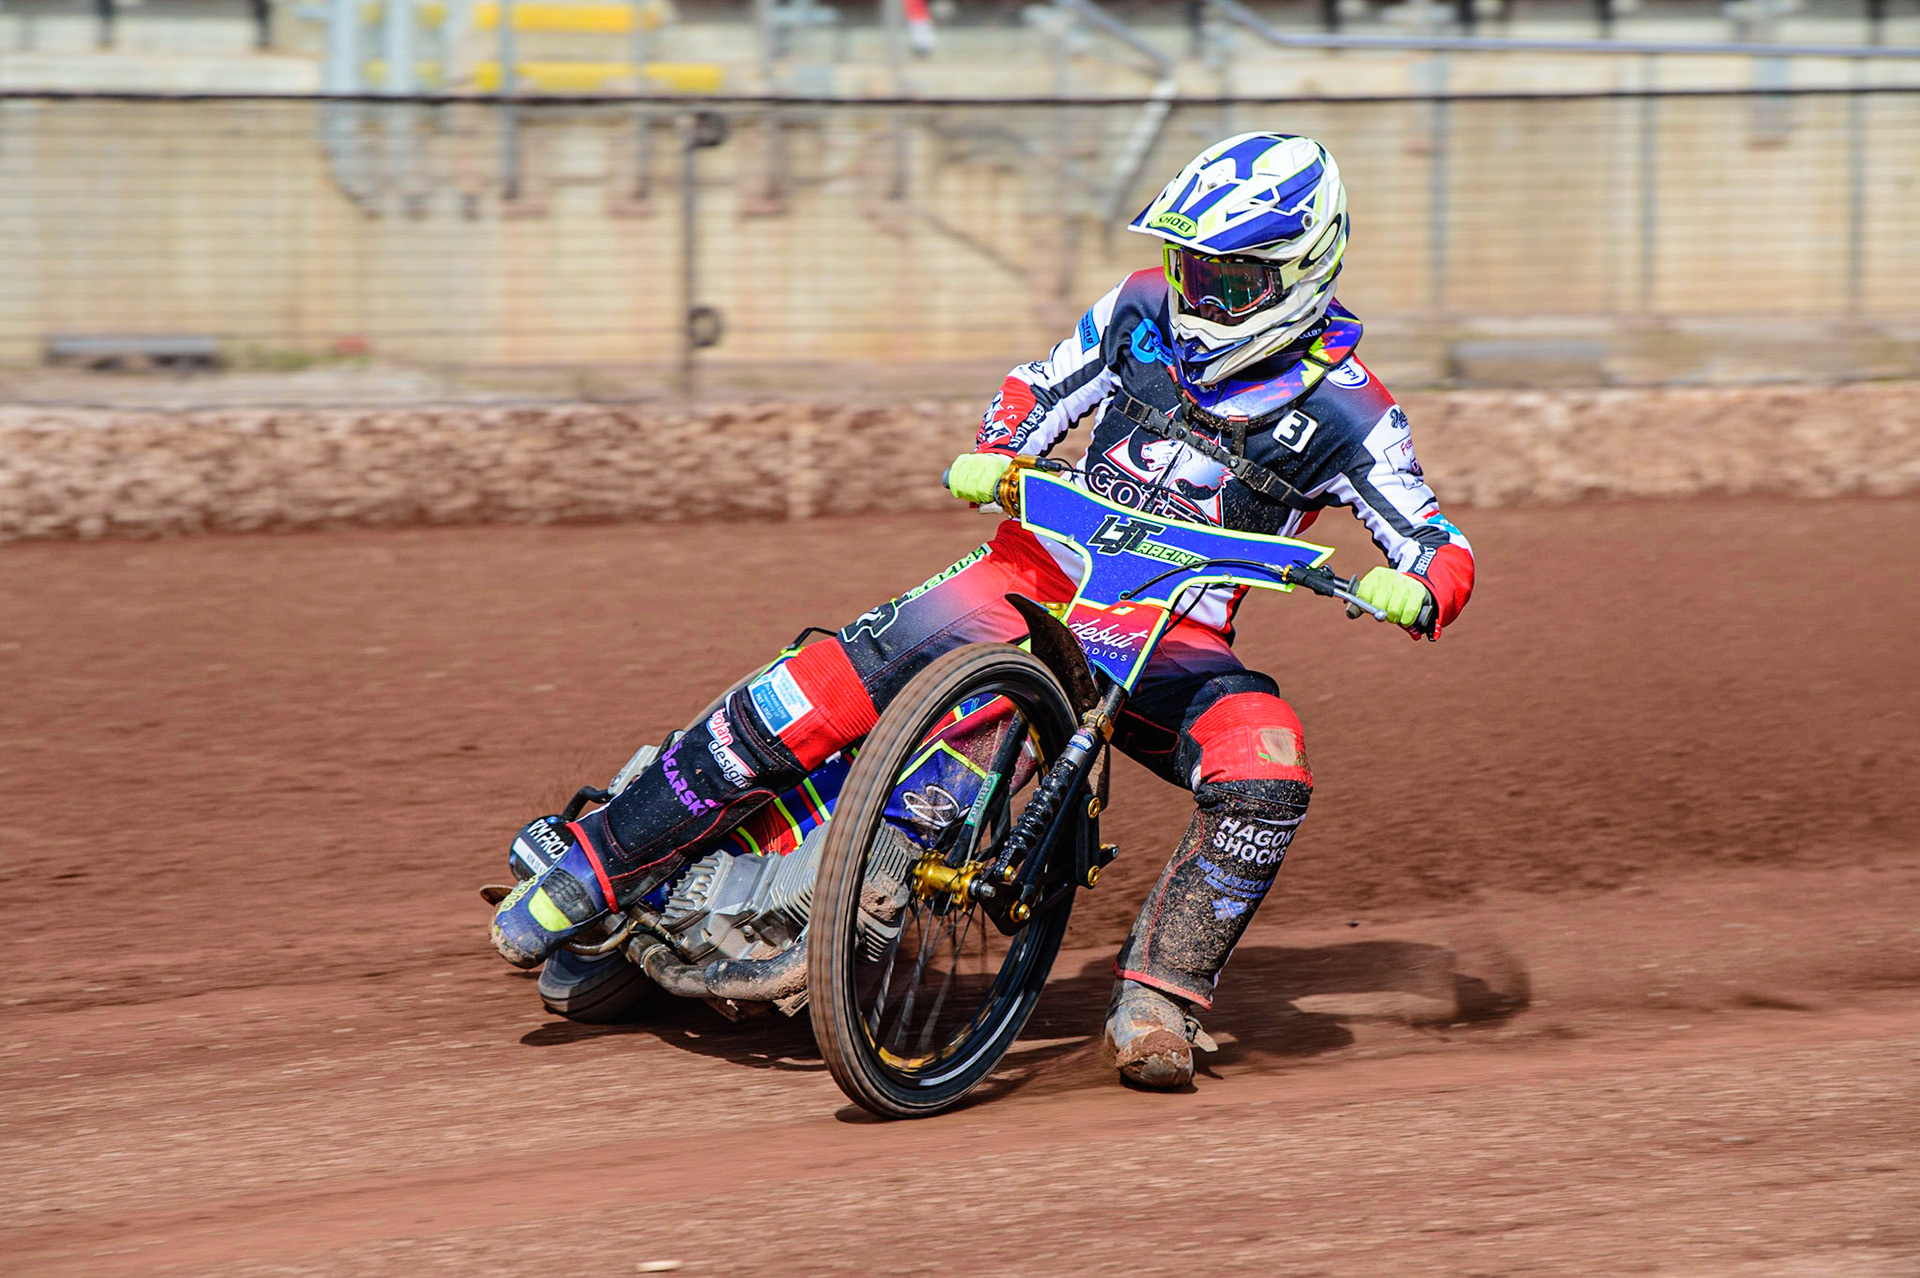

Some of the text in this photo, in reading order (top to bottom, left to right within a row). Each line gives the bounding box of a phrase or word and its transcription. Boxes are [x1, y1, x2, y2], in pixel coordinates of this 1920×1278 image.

[1156, 215, 1192, 233] SHOEI
[1278, 411, 1309, 447] 3
[1087, 515, 1205, 569] LJT RACING
[760, 703, 773, 719] LING
[1213, 831, 1286, 864] SHOCKS
[1219, 817, 1295, 847] HAGON
